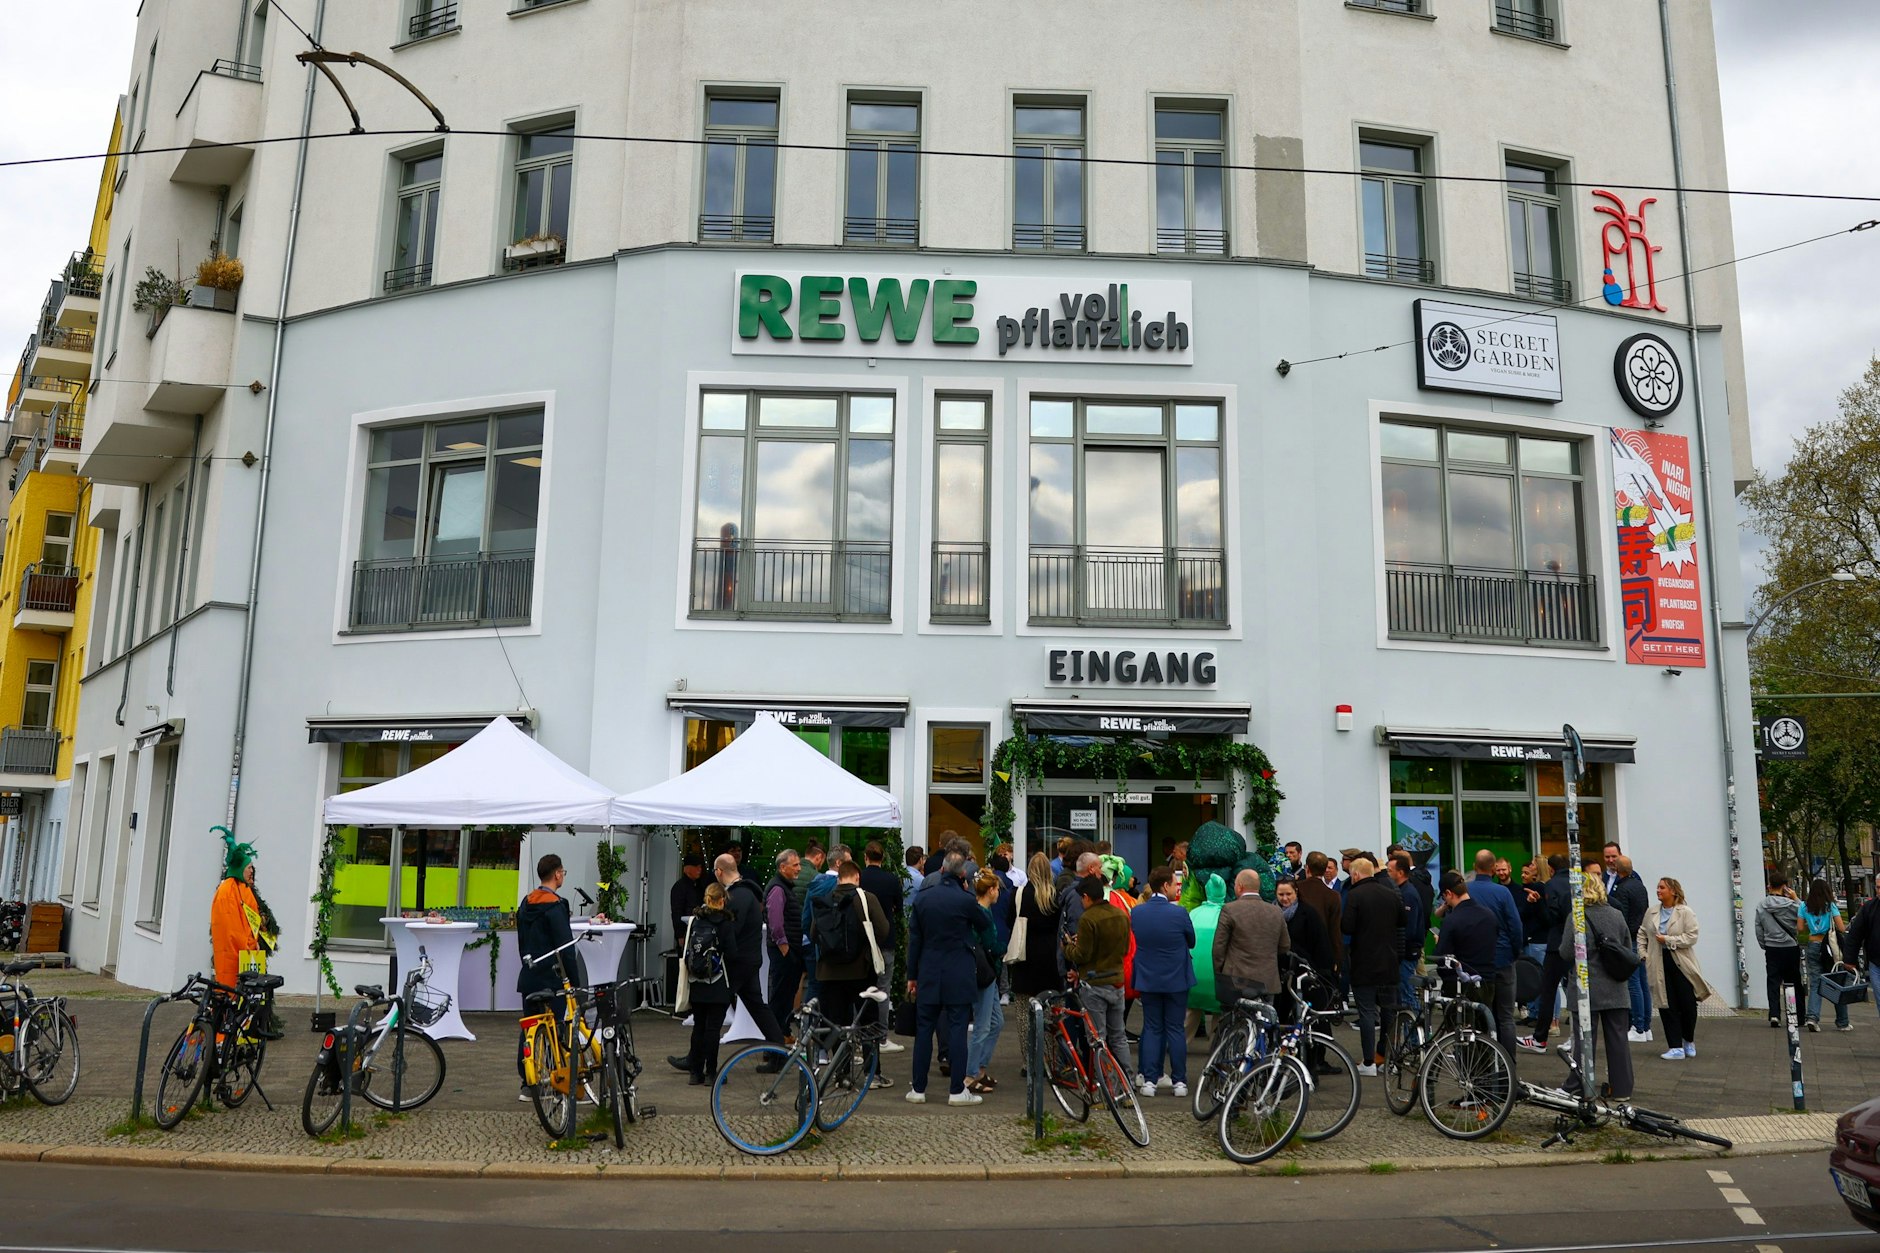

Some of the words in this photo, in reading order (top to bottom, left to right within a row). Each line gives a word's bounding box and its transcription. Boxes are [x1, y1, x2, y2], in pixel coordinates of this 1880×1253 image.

[738, 273, 981, 345] REWE
[1060, 283, 1129, 322] voll
[997, 303, 1189, 355] pflanzlich
[1477, 330, 1549, 352] SECRET
[1473, 348, 1555, 371] GARDEN
[1490, 367, 1508, 375] VEGAN
[1661, 459, 1684, 482] INARI
[1666, 477, 1690, 501] NIGIRI
[1658, 577, 1695, 590] #VEGANSUSHI
[1660, 598, 1697, 610] #PLANTBASED
[1662, 619, 1684, 630] #NOFISH
[1643, 643, 1661, 652] GET
[1675, 645, 1700, 654] HERE
[1049, 650, 1216, 684] EINGANG
[798, 716, 833, 725] pflanzlich
[809, 712, 823, 720] voll
[1154, 718, 1167, 726] voll
[1100, 716, 1142, 730] REWE
[381, 729, 411, 740] REWE
[1490, 745, 1525, 758] REWE
[1, 798, 19, 807] BIER
